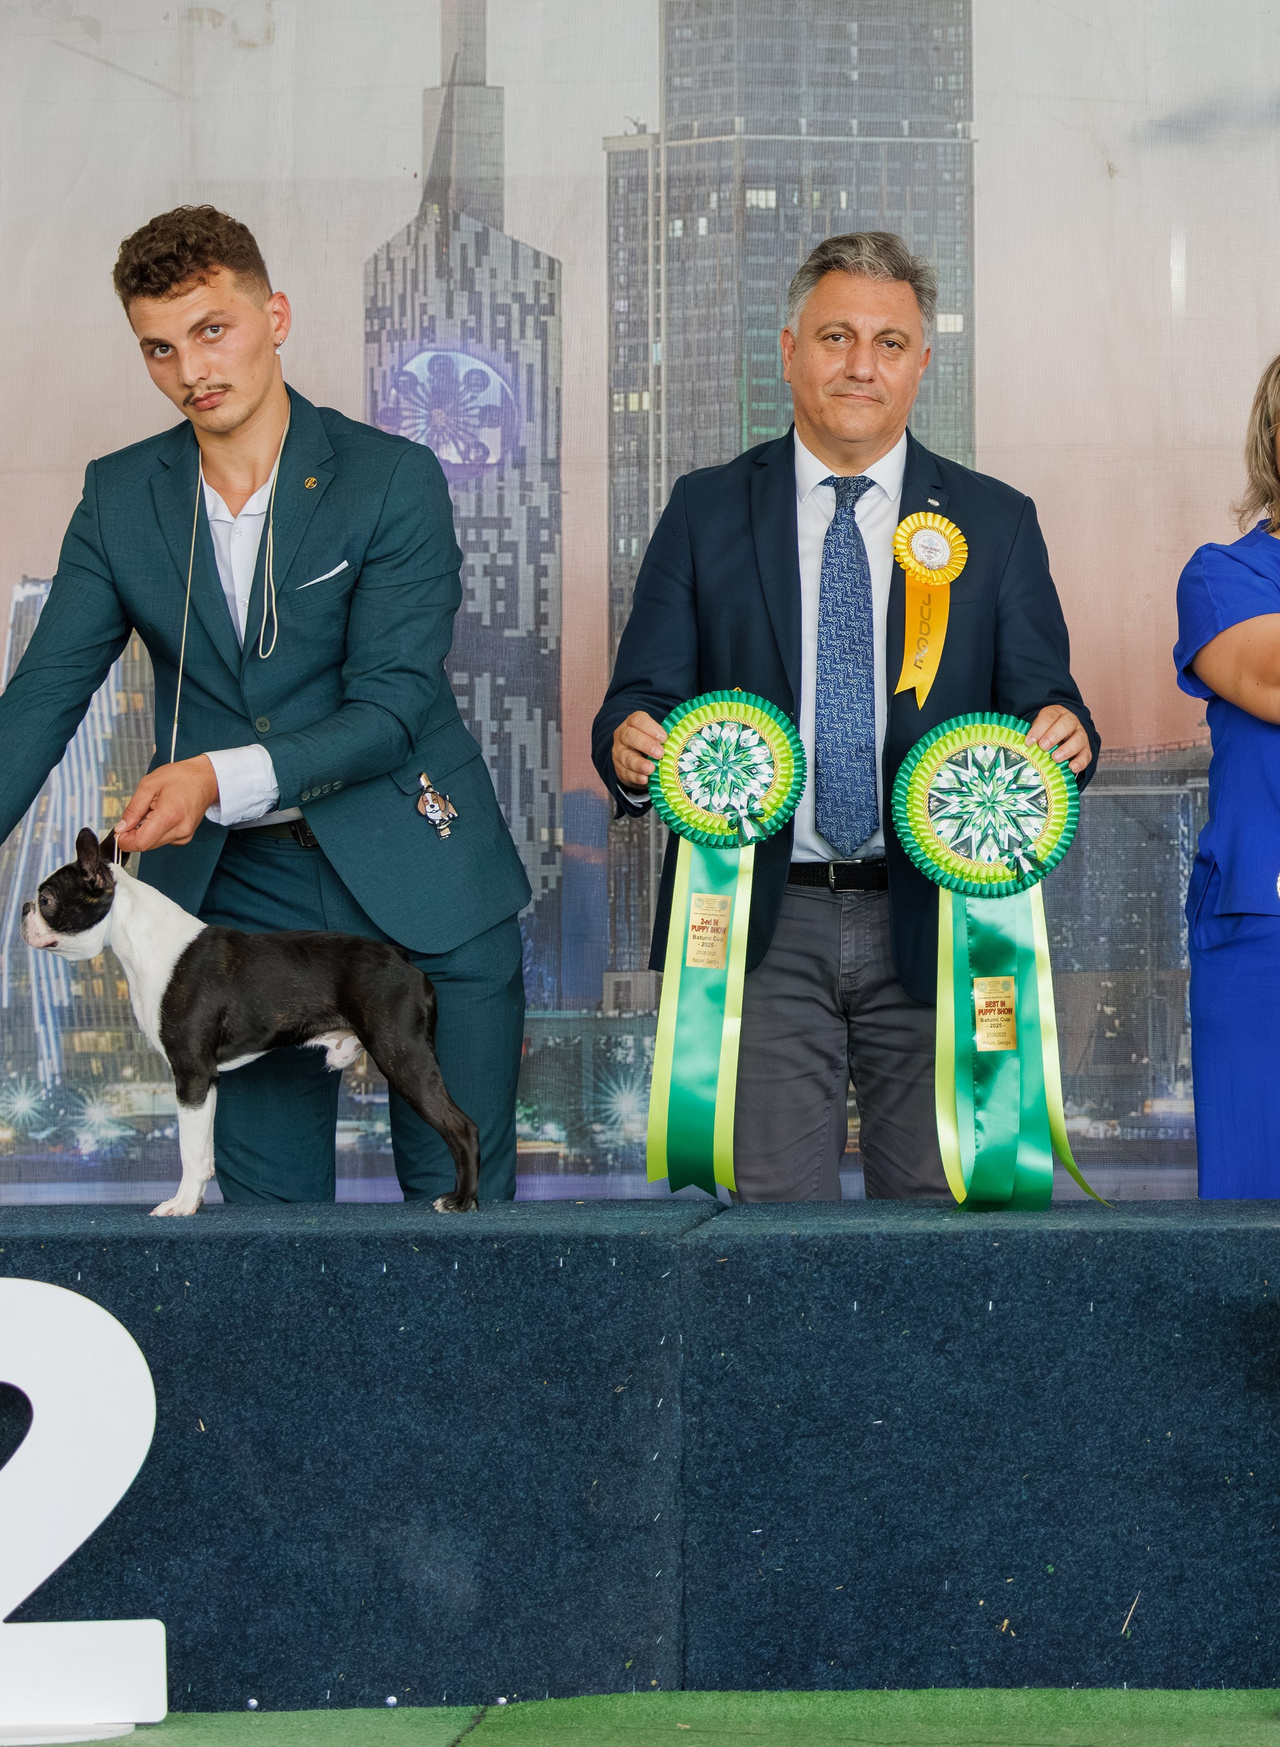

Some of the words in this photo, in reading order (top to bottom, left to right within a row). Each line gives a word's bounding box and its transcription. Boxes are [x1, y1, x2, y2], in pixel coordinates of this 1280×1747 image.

[914, 593, 932, 670] JUDGE
[691, 925, 709, 933] PUPPY
[978, 1008, 996, 1016] PUPPY
[0, 1277, 168, 1725] 2
